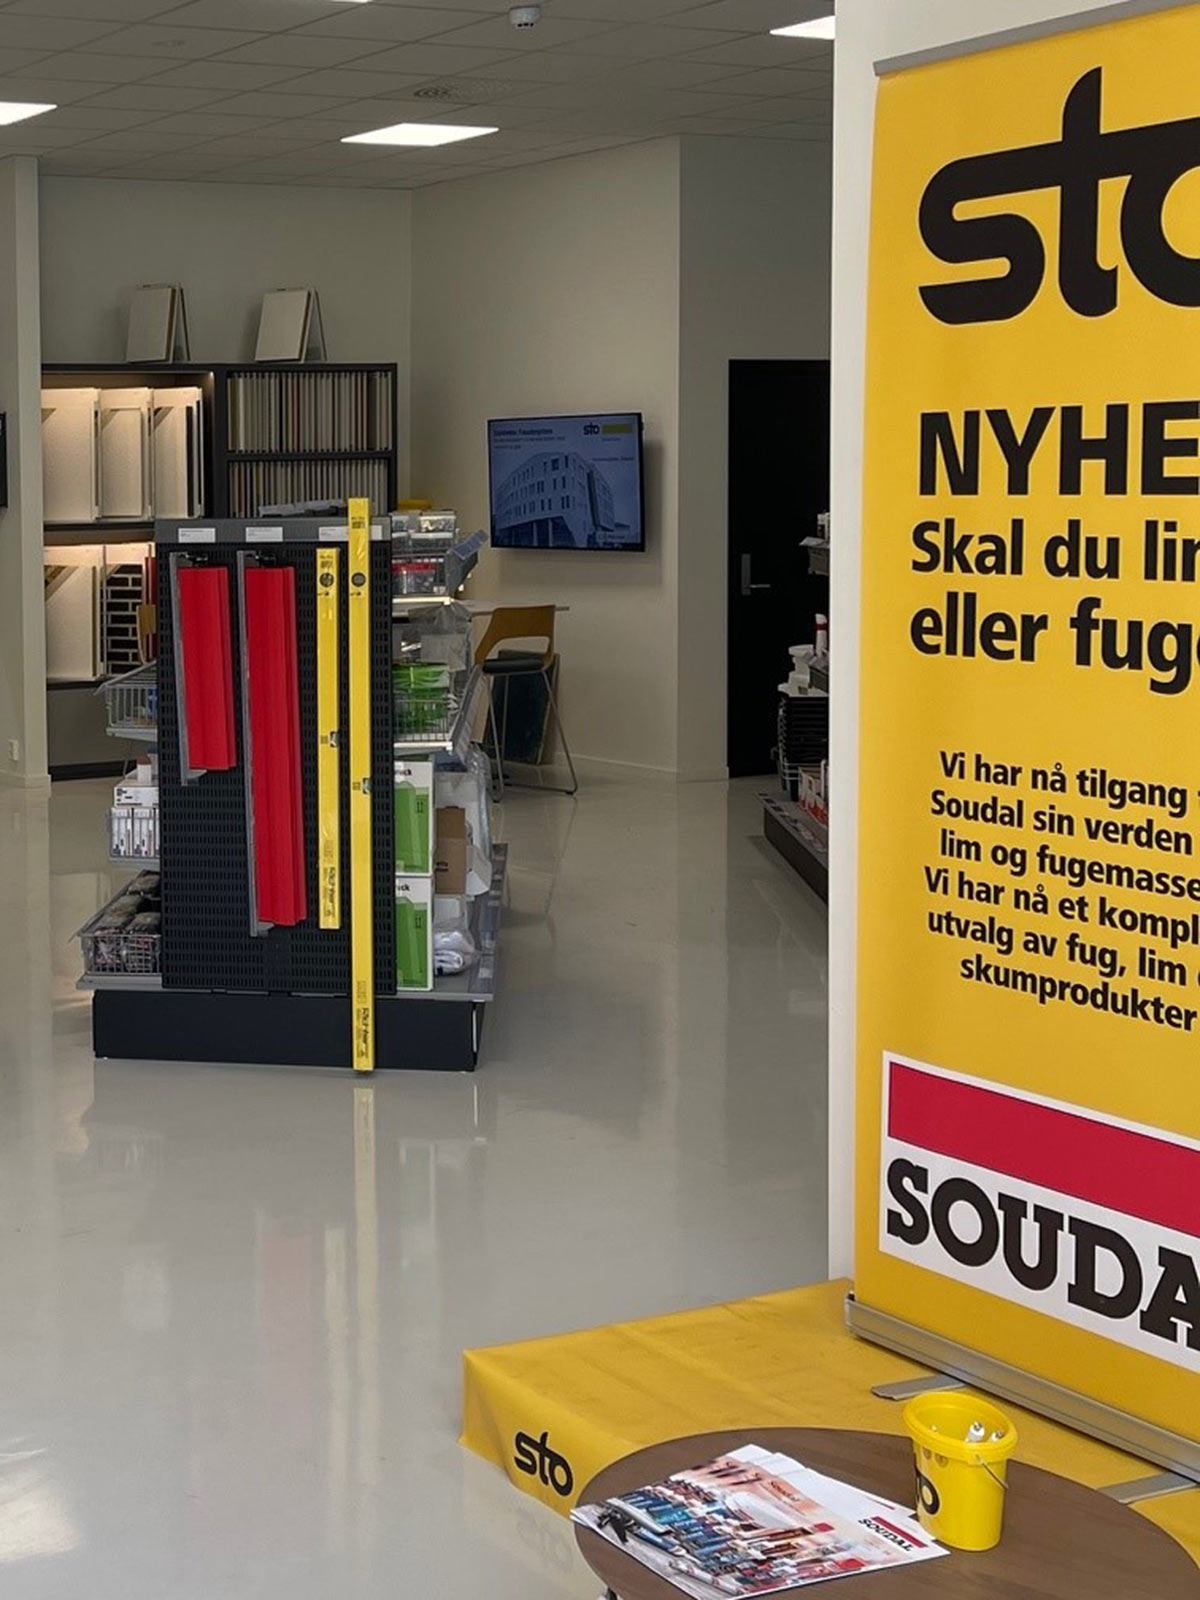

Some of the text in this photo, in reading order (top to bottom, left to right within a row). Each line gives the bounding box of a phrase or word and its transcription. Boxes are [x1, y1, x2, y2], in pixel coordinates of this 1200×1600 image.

[918, 66, 1200, 325] sto
[583, 422, 600, 436] sto
[919, 400, 1200, 496] NYHE
[912, 518, 1024, 576] Skal
[1044, 519, 1120, 579] du
[910, 591, 1200, 695] eller fug
[940, 751, 966, 780] Vi
[974, 754, 1022, 787] har
[1031, 762, 1067, 793] nå
[1076, 768, 1188, 818] tilgang
[931, 789, 1193, 856] Soudal sin verden
[940, 828, 1200, 902] lim og fugemasse
[924, 866, 1200, 950] Vi har nå et kompl
[928, 911, 1187, 987] utvalg av fug, lim
[960, 954, 1197, 1033] skumprodukter
[887, 1157, 1200, 1352] SOUDA
[514, 1431, 574, 1497] sto
[858, 1518, 915, 1552] SOUDAL
